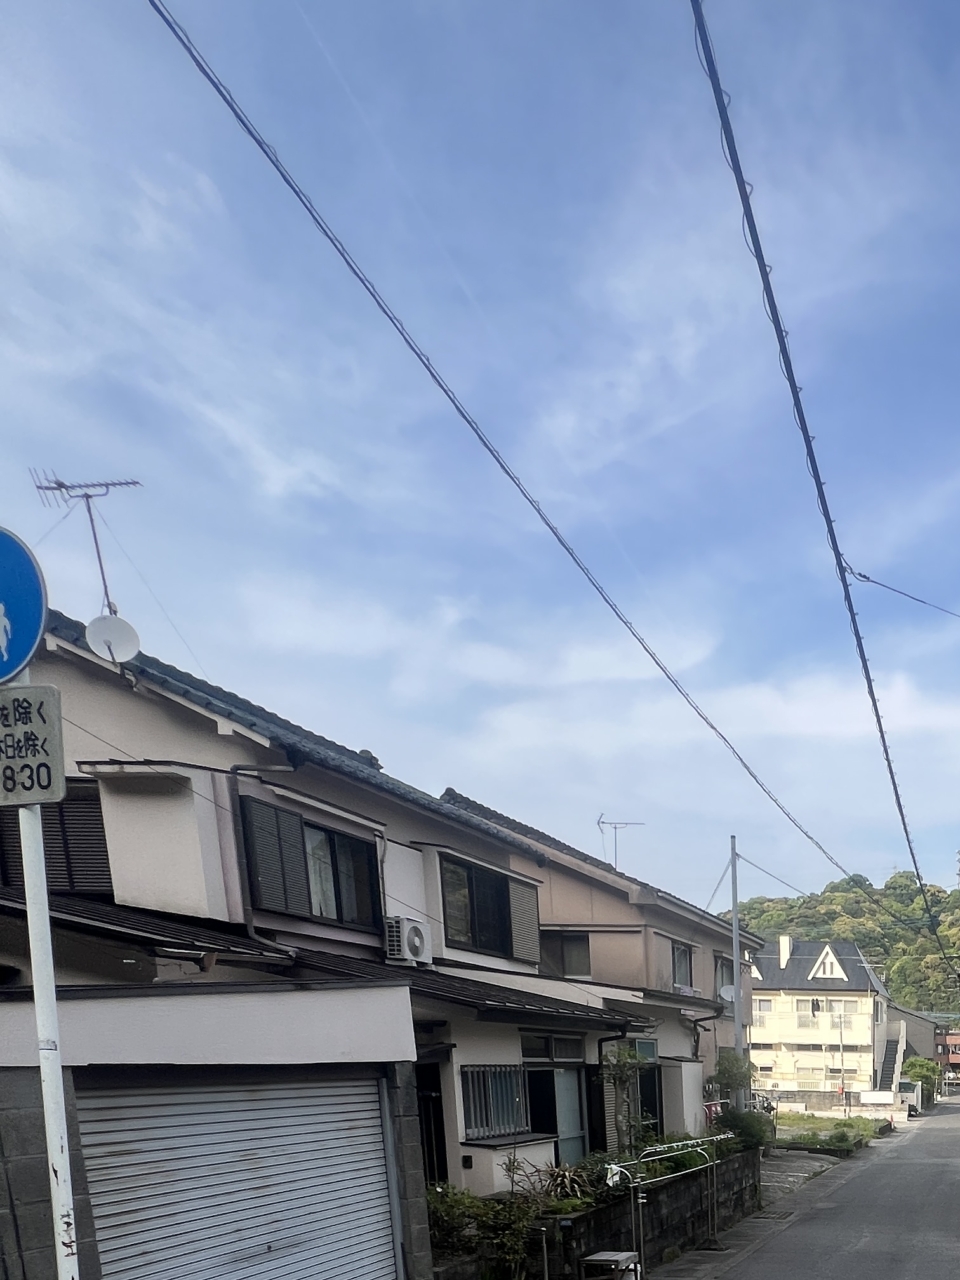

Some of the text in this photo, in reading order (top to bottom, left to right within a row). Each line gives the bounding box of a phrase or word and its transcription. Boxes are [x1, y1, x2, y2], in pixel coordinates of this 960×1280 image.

[0, 730, 50, 759] 日を除く
[2, 762, 52, 792] 8:30
